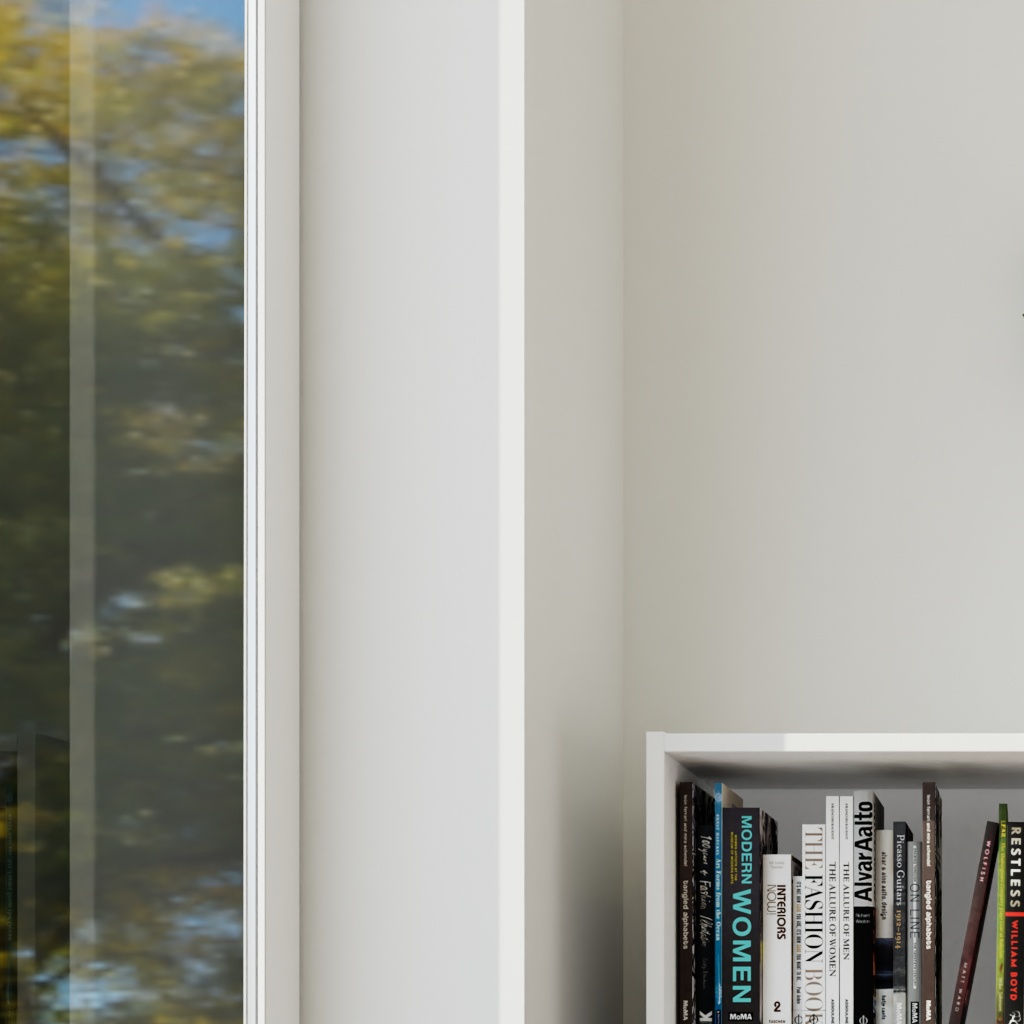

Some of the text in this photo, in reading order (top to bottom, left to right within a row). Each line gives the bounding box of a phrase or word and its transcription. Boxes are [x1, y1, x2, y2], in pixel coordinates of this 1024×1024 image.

[896, 835, 904, 906] Picasso Guitars
[979, 840, 991, 882] WOLFISH
[1010, 827, 1021, 908] RESTLESS
[732, 815, 752, 1003] MODERN WOMEN
[767, 885, 776, 915] NOW!
[777, 885, 786, 939] INTERIORS
[681, 912, 689, 949] alphabets
[805, 828, 823, 1024] THE FASHION BOOK
[1011, 920, 1019, 967] WILLIAM
[774, 1002, 781, 1012] 2
